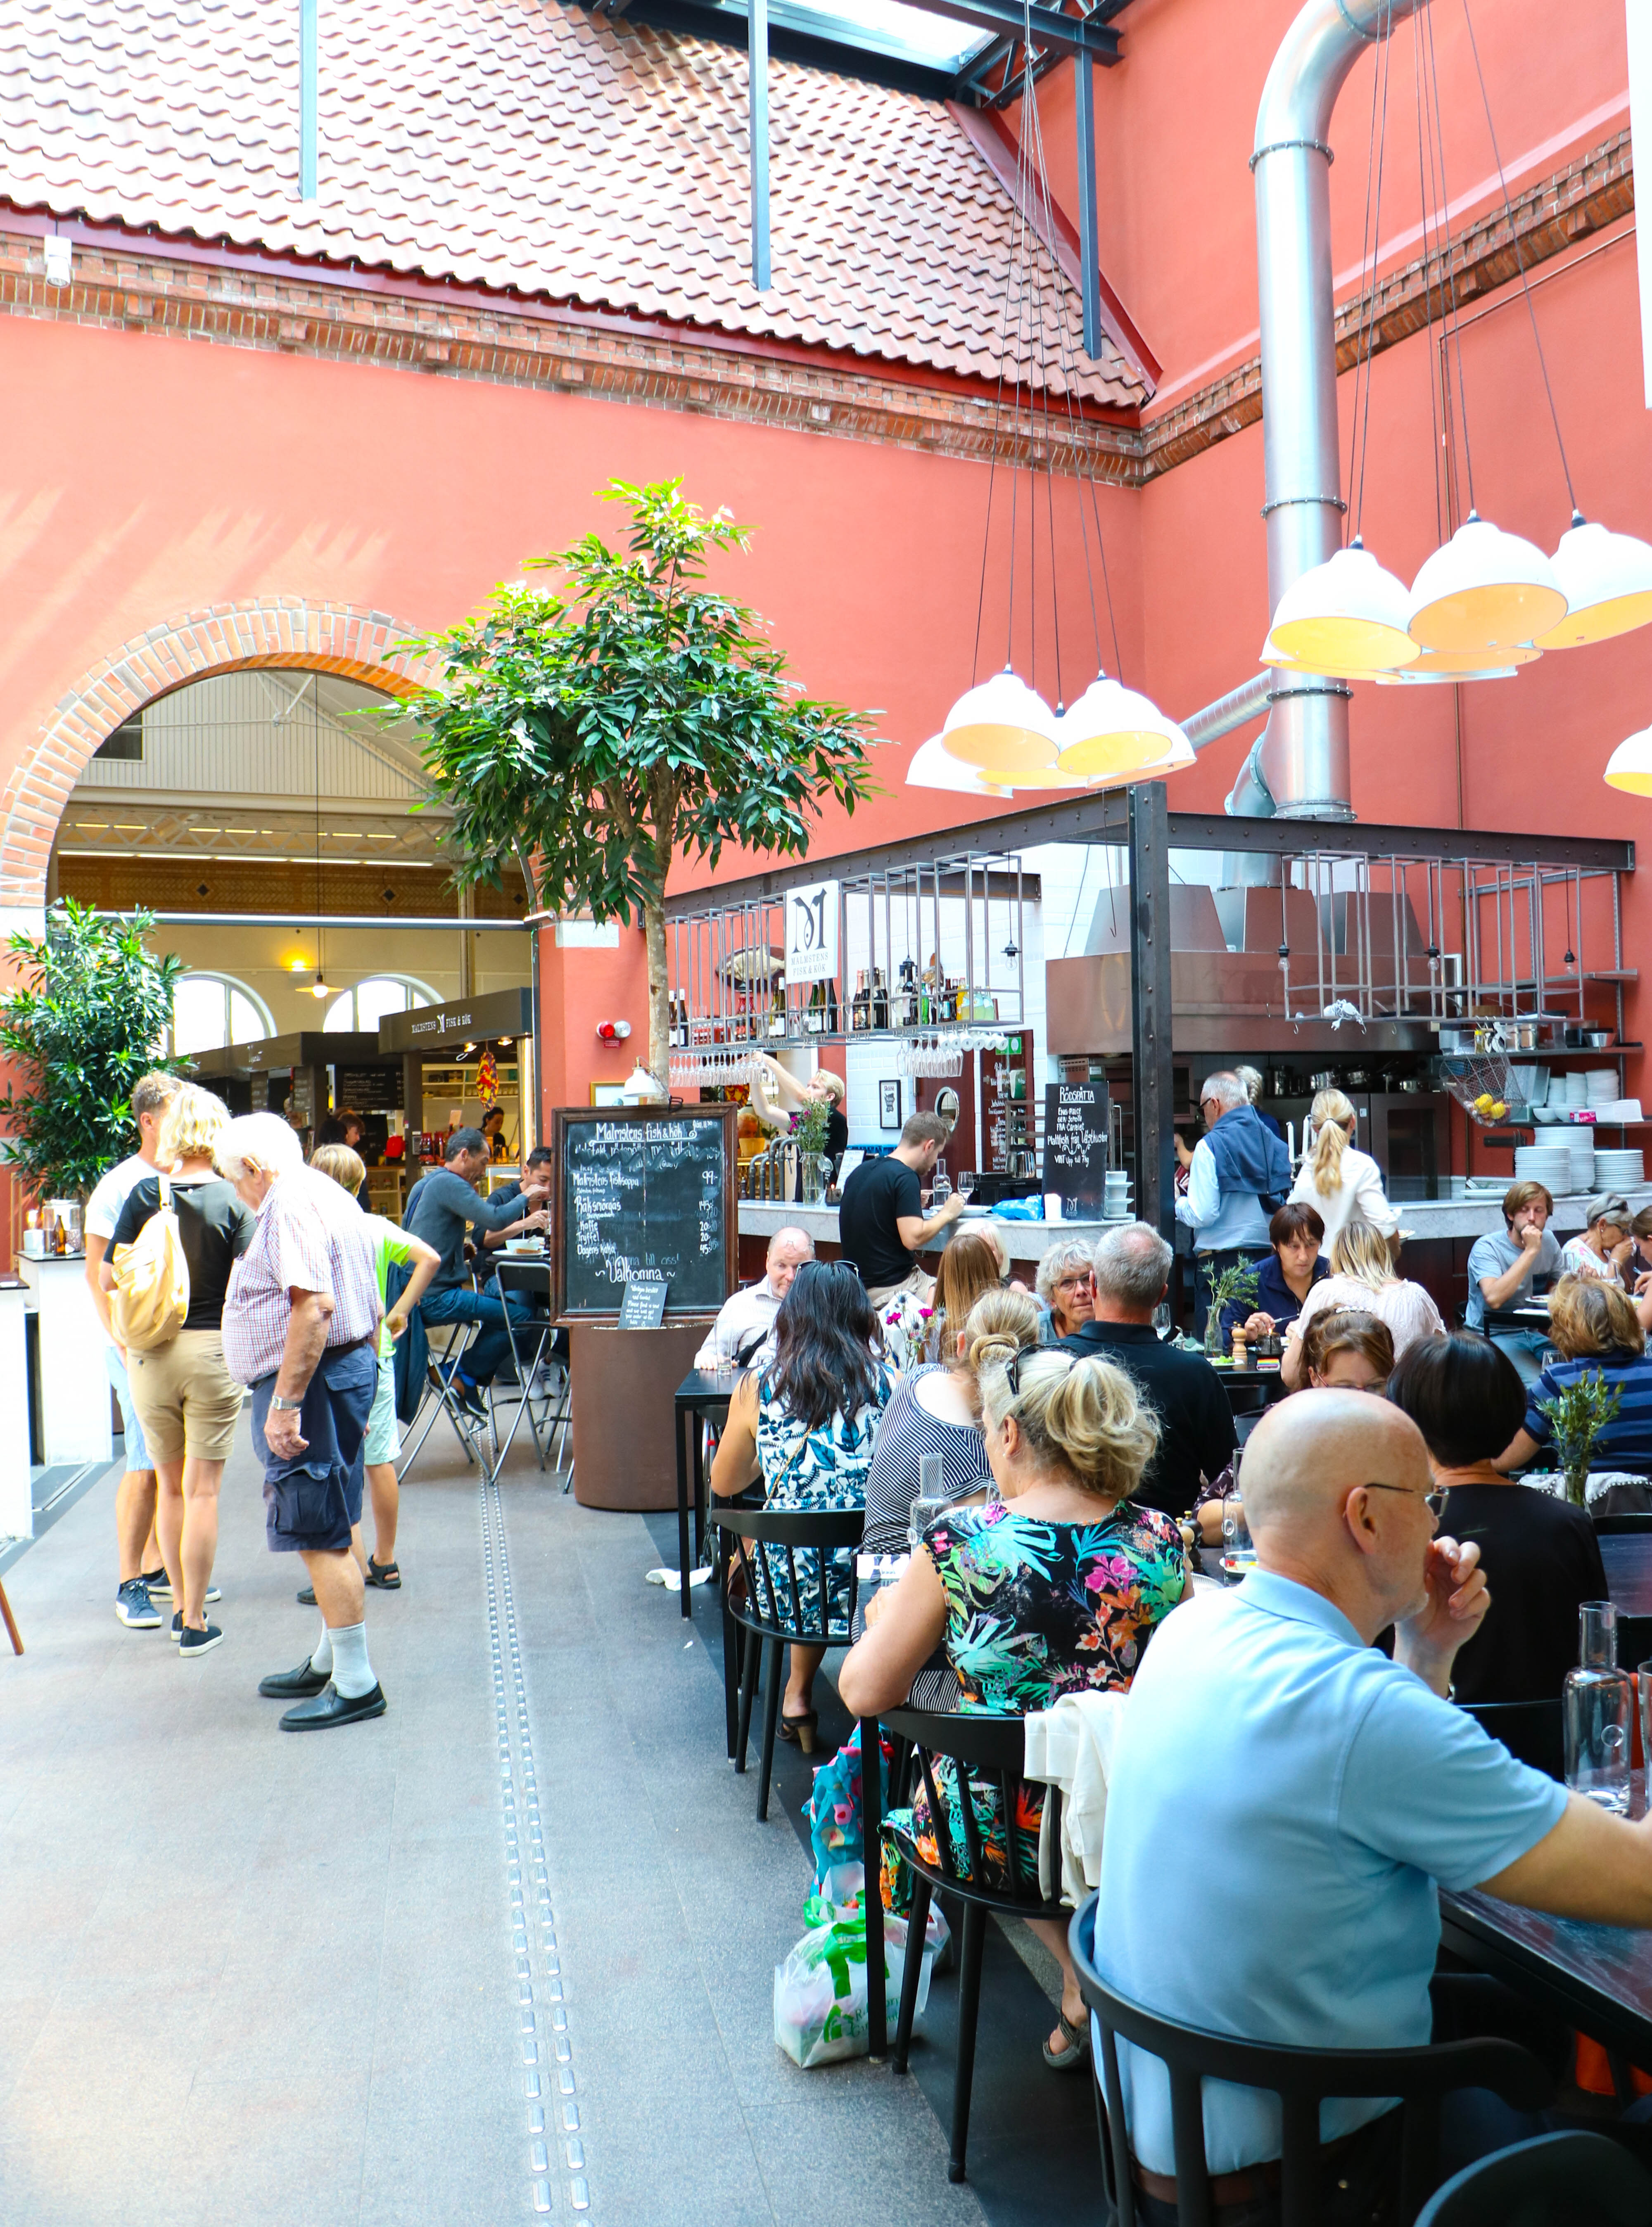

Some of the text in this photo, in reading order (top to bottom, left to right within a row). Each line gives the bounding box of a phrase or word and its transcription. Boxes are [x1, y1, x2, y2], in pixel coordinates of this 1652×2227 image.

[791, 952, 828, 965] MALMSTENS
[793, 963, 826, 976] FISK & KÖK
[411, 1021, 437, 1034] MALMSTENS
[446, 1017, 456, 1028] FISK
[457, 1016, 461, 1026] &
[462, 1014, 471, 1025] KÖK
[1059, 1086, 1095, 1102] RÖDSPÄTTA
[596, 1122, 682, 1142] Malmstens fisk & kök
[1047, 1134, 1069, 1148] Plattfisk
[1070, 1131, 1080, 1150] från
[573, 1171, 639, 1190] Malmstens fisksoppa
[574, 1195, 621, 1215] Räksmörgås
[580, 1220, 598, 1232] Kaffe
[576, 1231, 599, 1245] Tryffel
[577, 1243, 616, 1258] Dagens kaka
[605, 1255, 664, 1283] Välkomna
